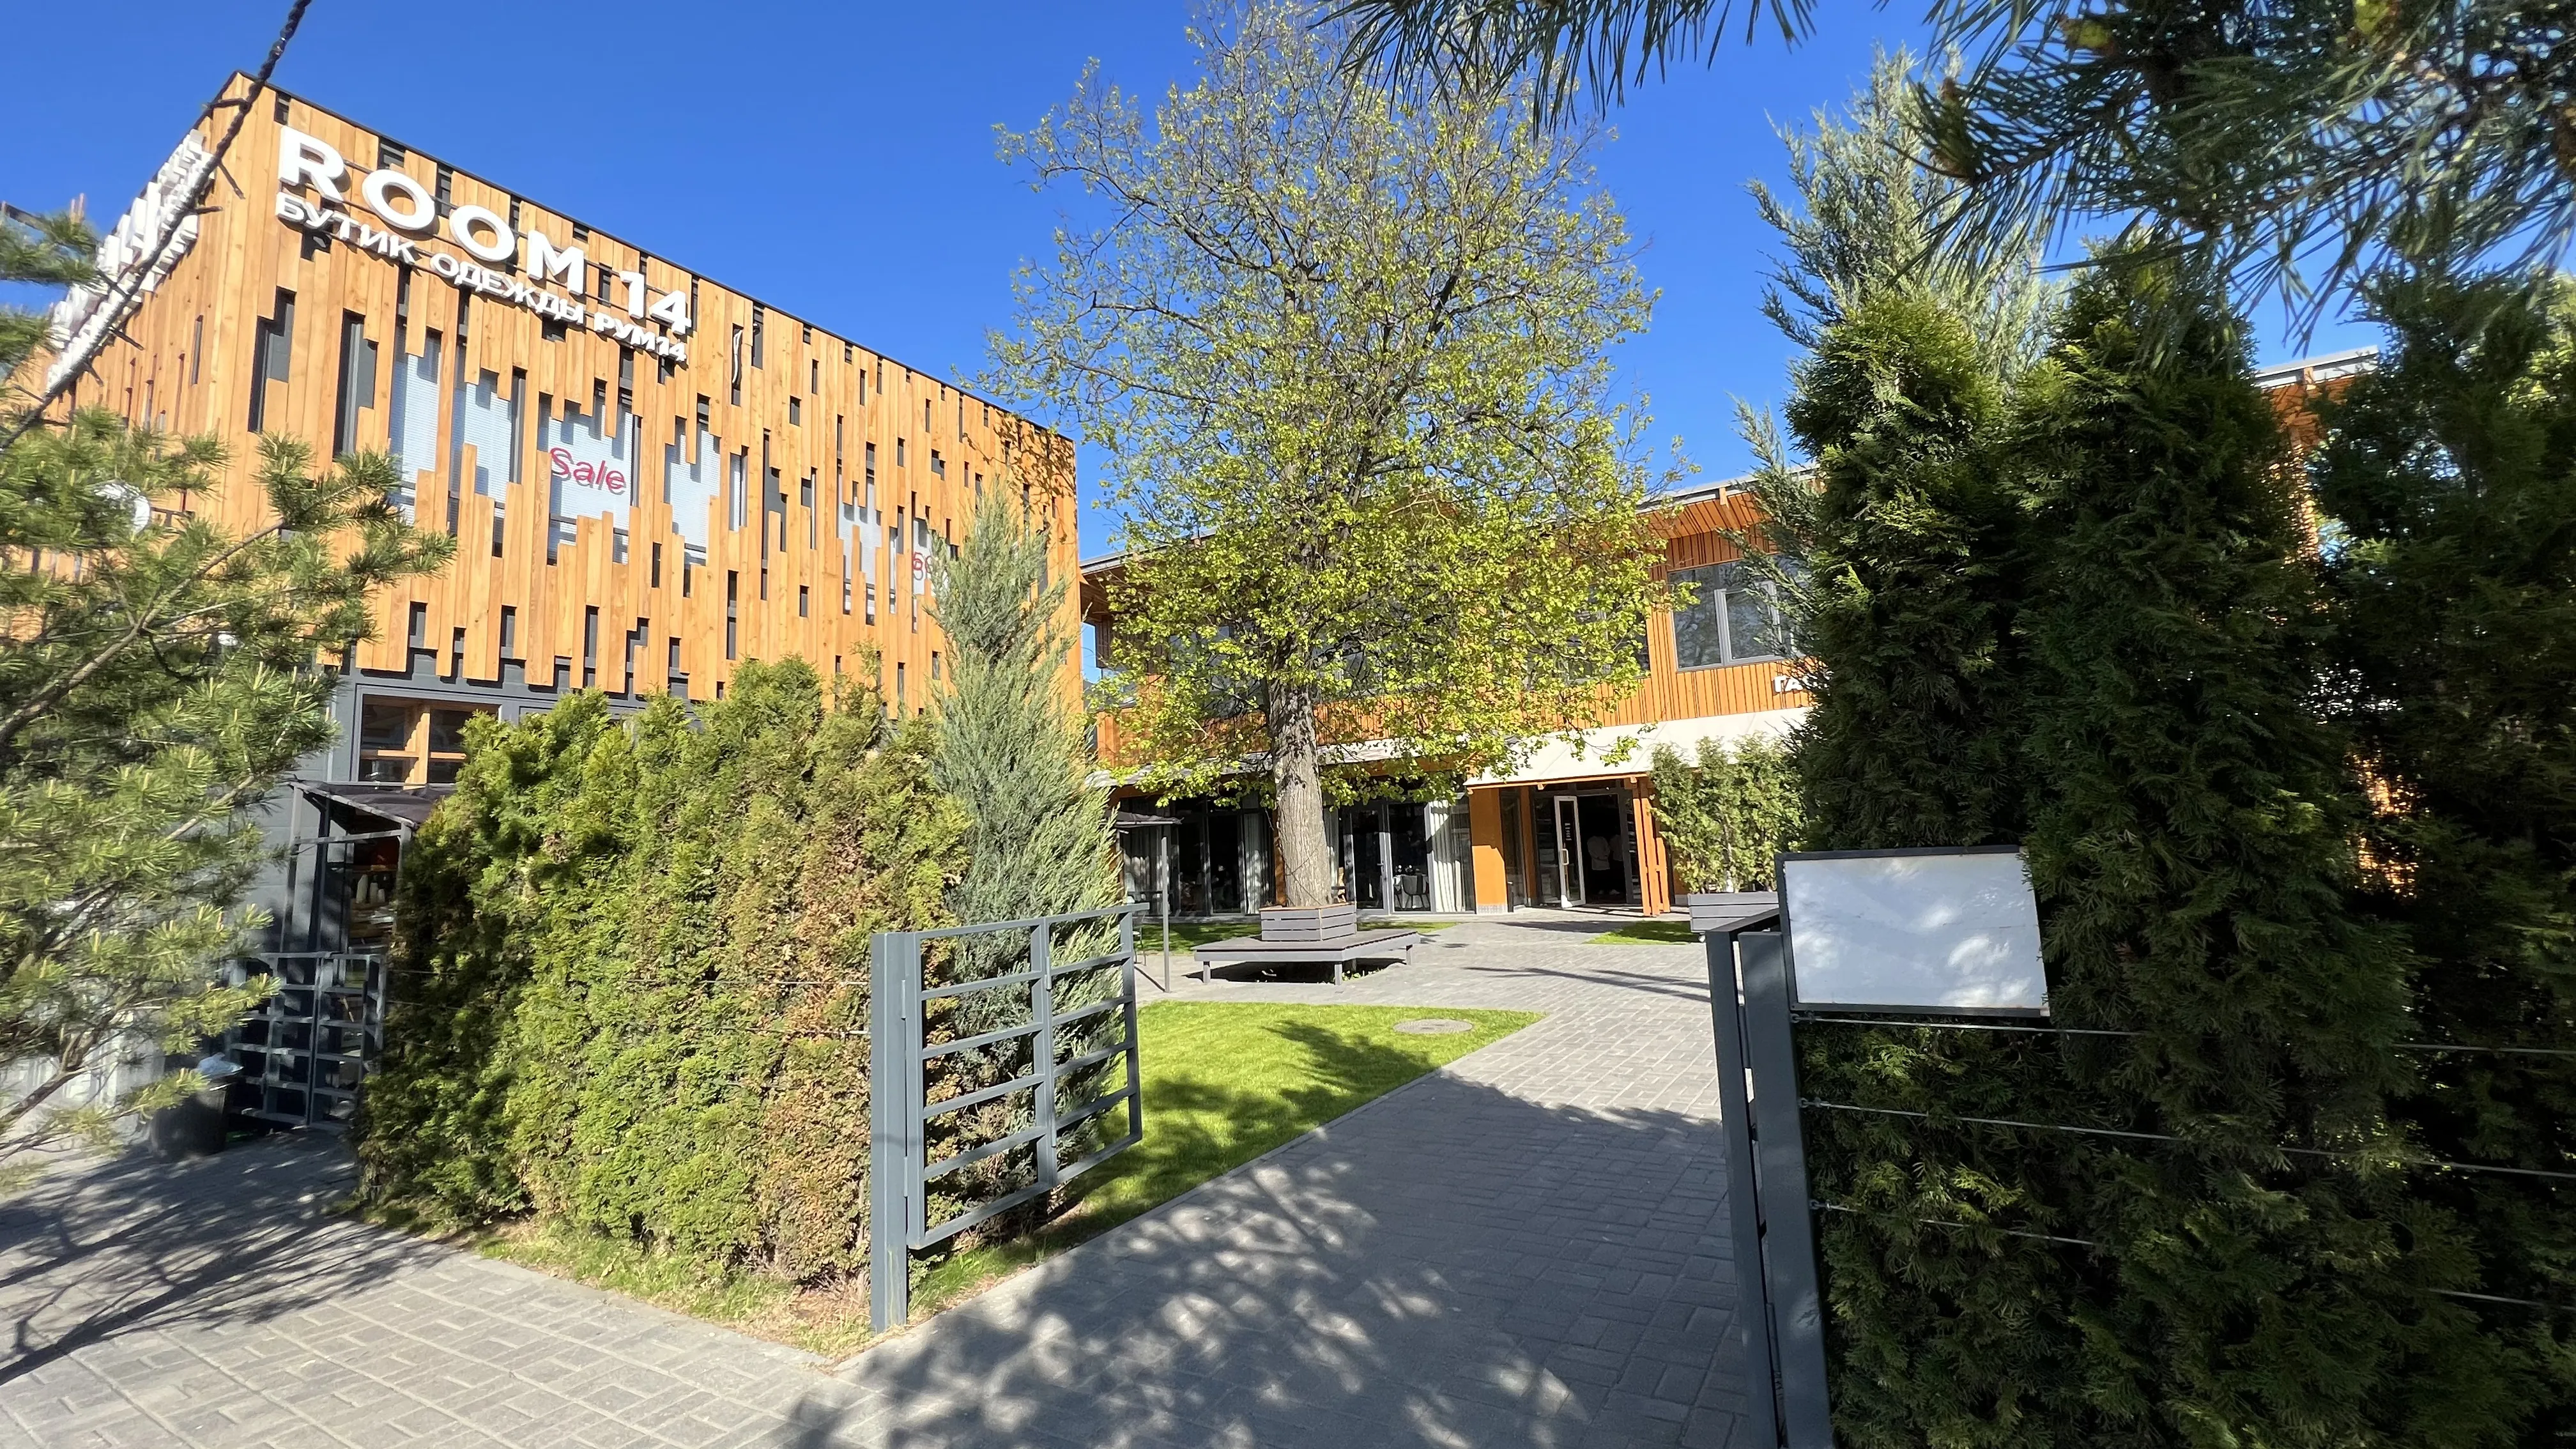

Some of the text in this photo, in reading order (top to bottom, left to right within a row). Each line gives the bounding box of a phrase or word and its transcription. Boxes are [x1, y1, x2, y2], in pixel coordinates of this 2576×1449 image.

[275, 191, 687, 362] БУТИК ОДЕЖДЫ РУМ14
[277, 125, 585, 295] ROOM
[619, 270, 692, 335] 14
[549, 447, 625, 490] Sale
